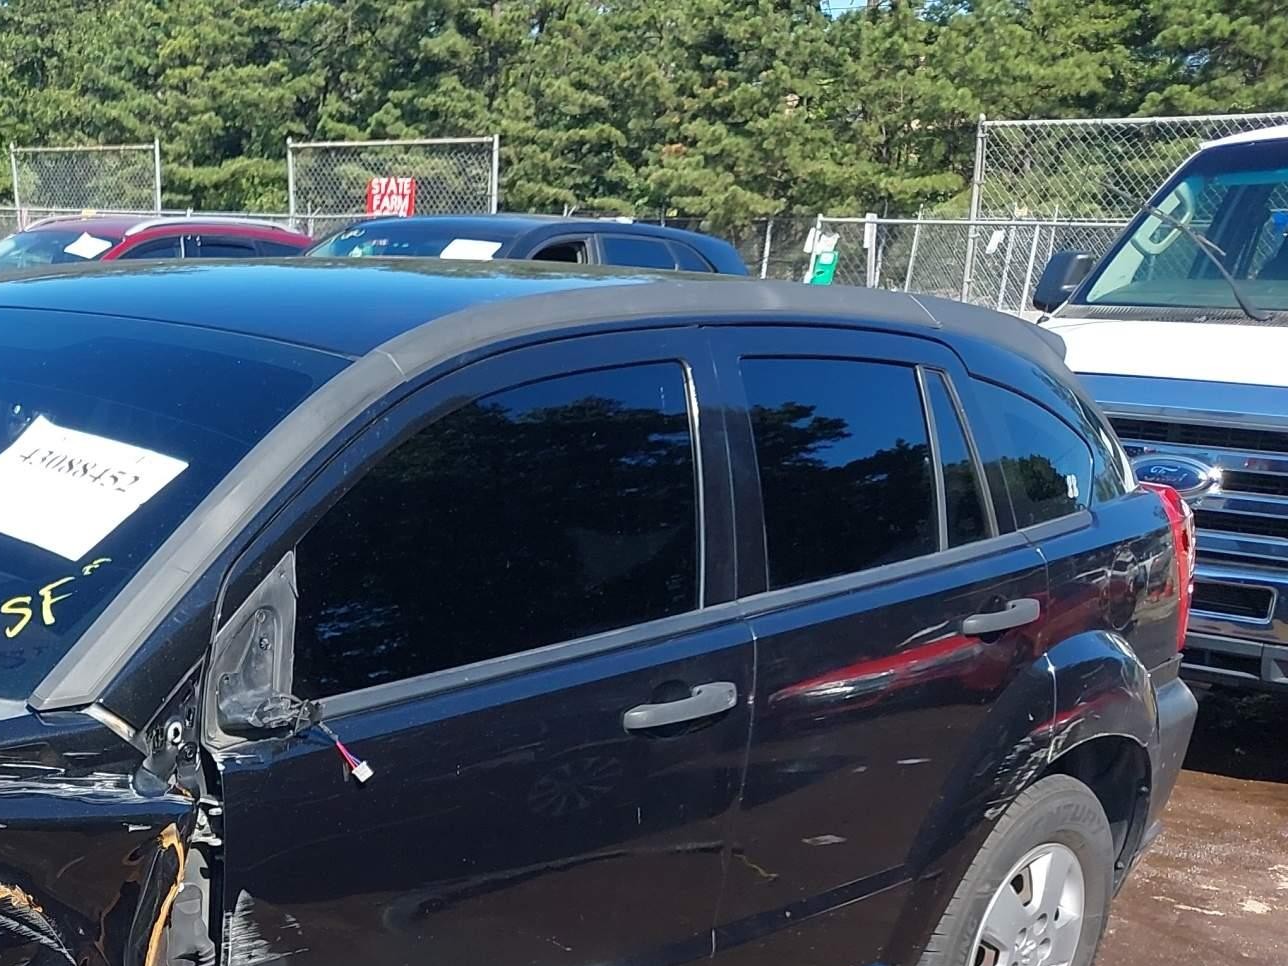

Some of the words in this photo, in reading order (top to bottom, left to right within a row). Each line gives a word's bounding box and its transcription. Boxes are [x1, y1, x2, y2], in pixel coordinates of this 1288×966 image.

[371, 177, 411, 194] STATE
[372, 194, 410, 211] FARM
[19, 447, 140, 493] 43088452
